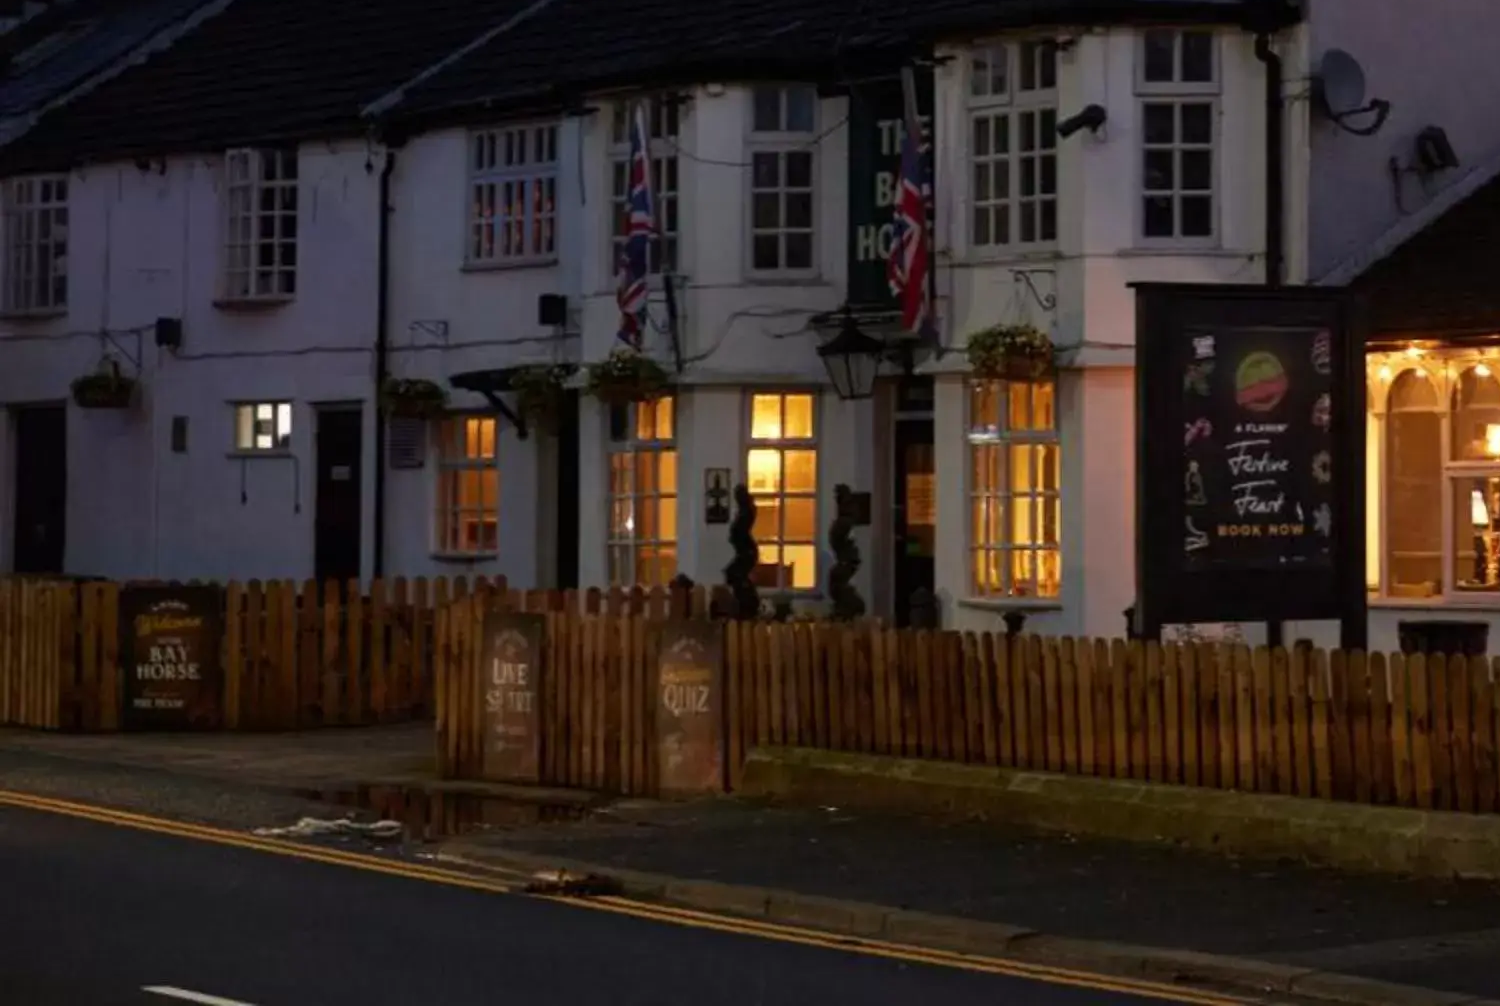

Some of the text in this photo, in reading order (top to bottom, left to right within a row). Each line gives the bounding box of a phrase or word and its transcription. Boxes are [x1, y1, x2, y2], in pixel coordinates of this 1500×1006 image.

[1231, 480, 1285, 516] Feast
[1217, 524, 1305, 537] BOOK NOW
[663, 685, 710, 716] QUIZ
